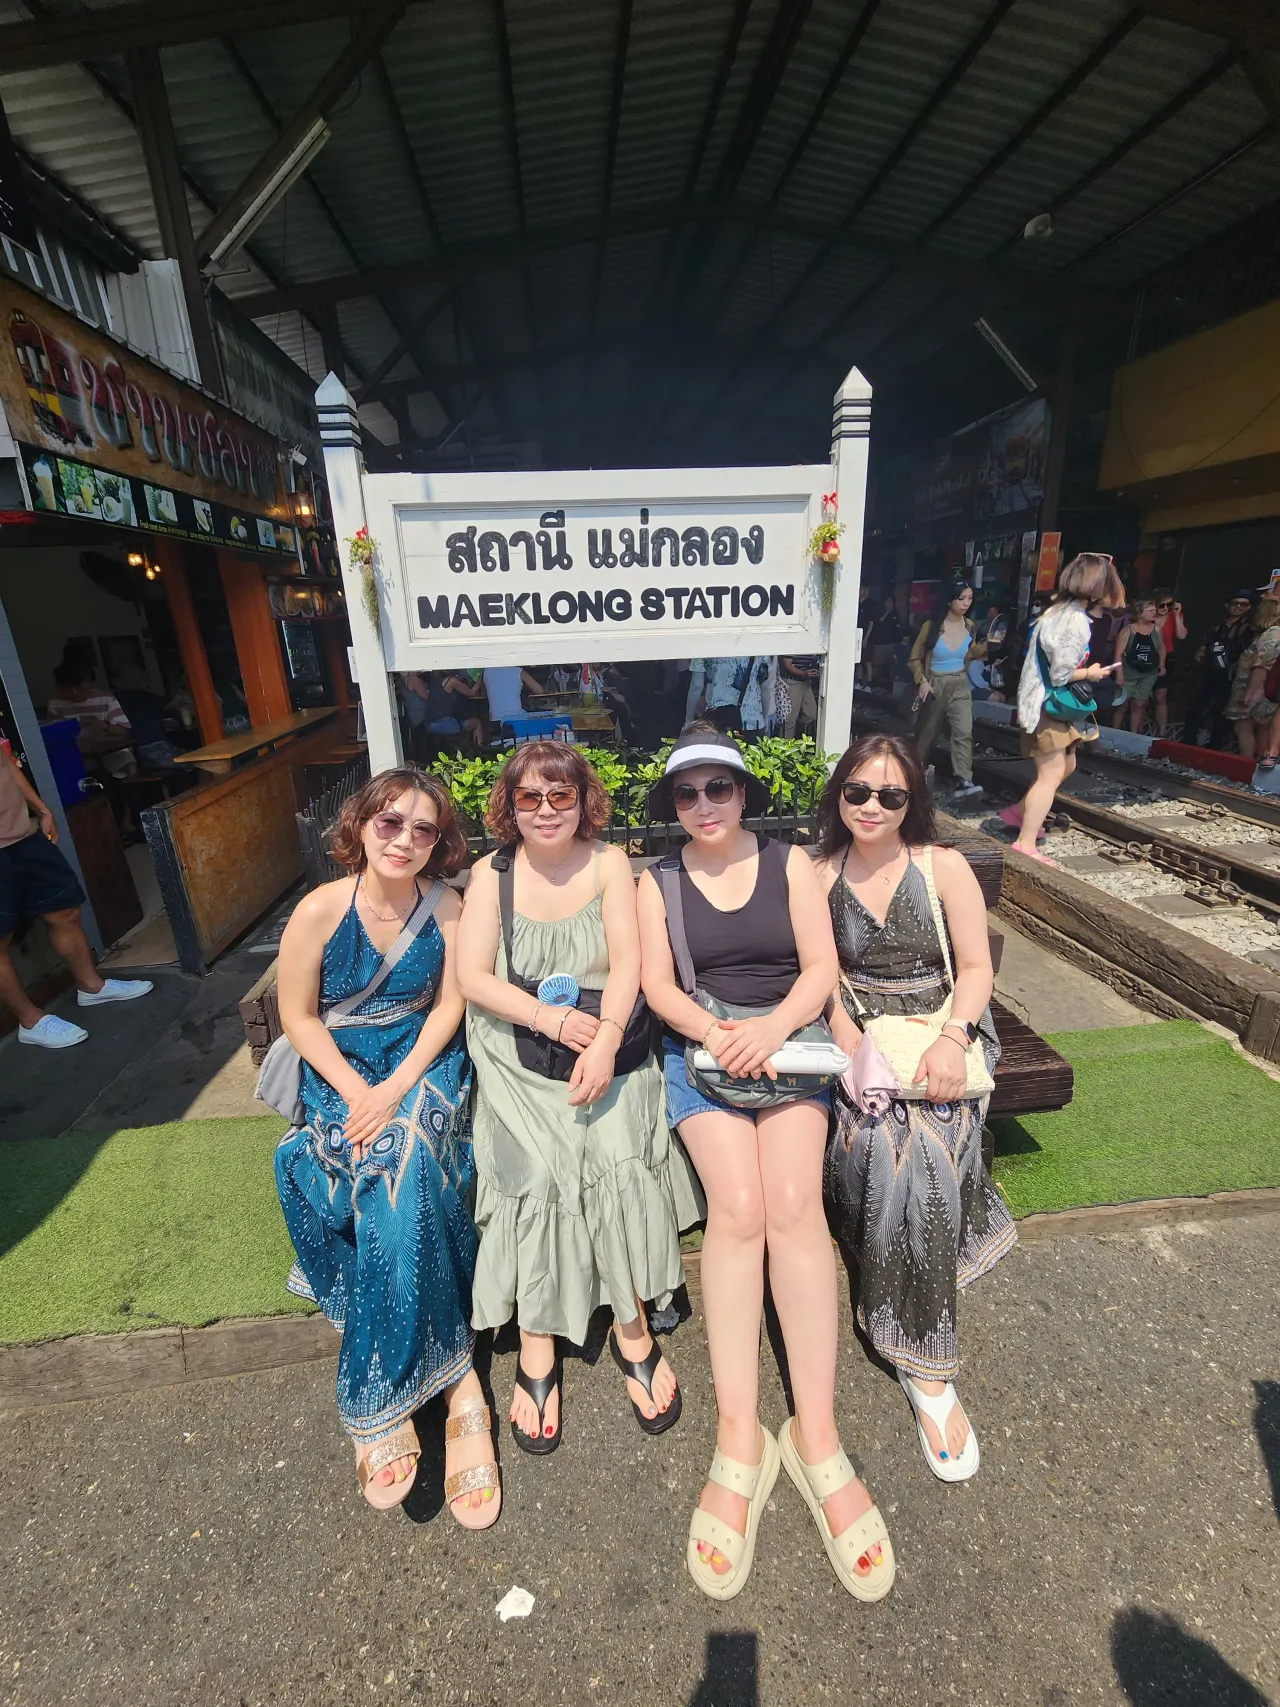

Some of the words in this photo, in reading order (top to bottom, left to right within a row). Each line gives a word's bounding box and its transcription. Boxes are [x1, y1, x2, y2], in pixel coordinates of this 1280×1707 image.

[446, 510, 573, 573] สถานี
[588, 508, 765, 568] แม่กลอง
[418, 590, 633, 629] MAEKLONG
[640, 585, 795, 621] STATION
